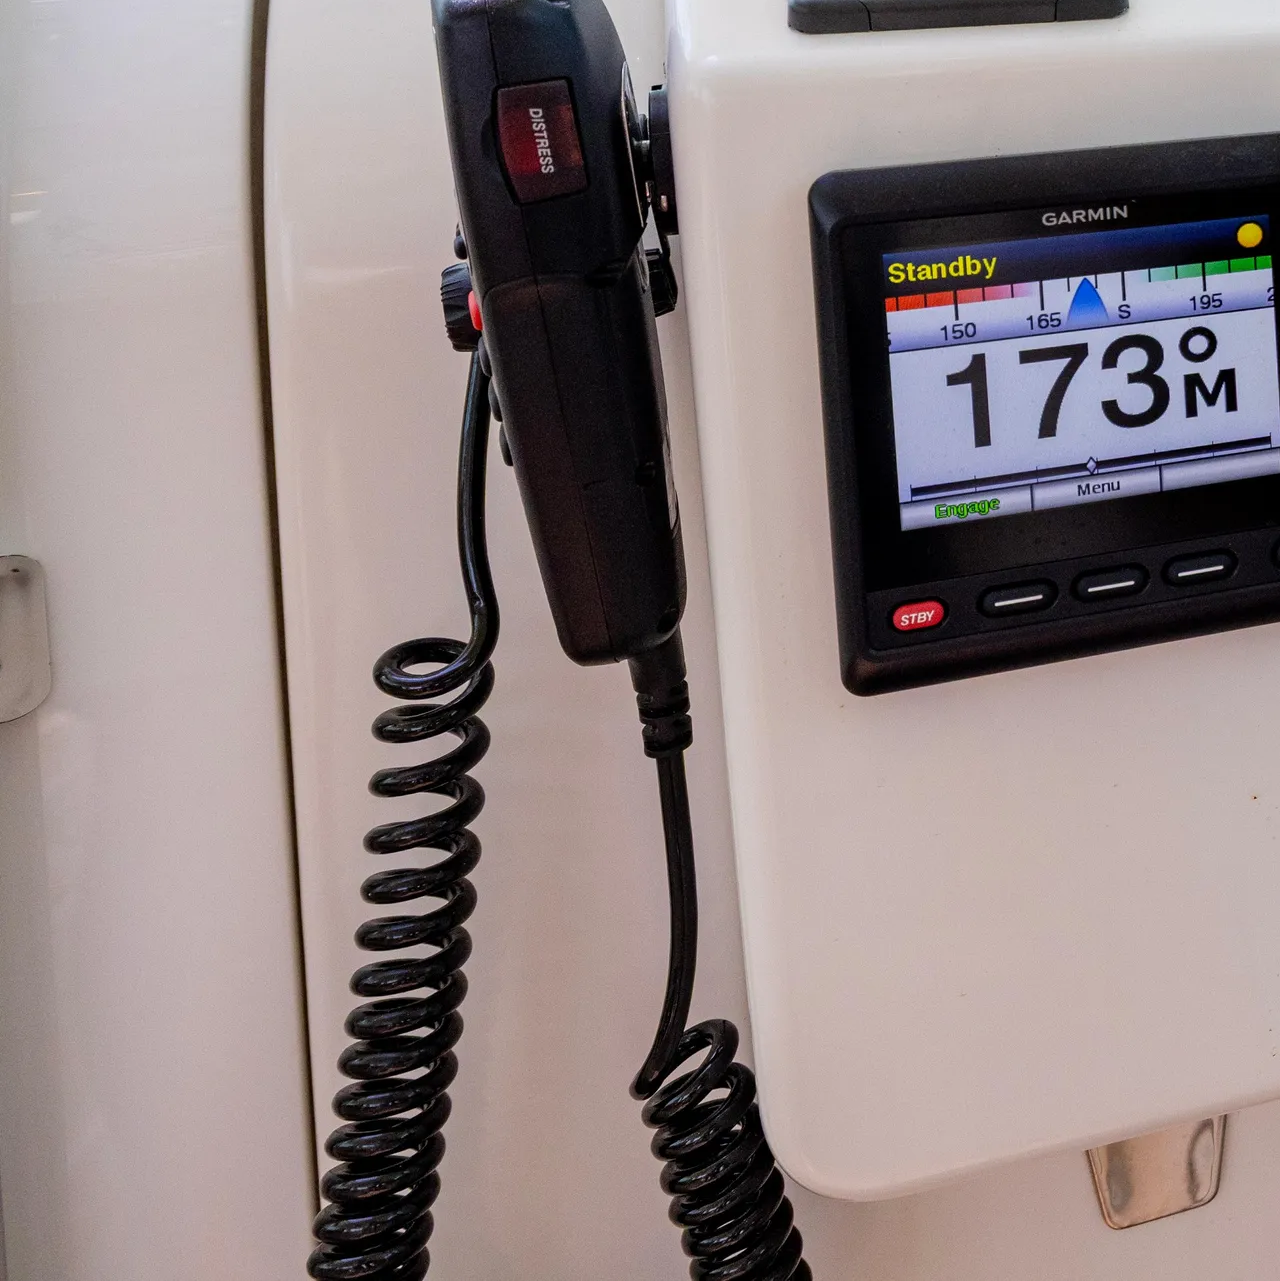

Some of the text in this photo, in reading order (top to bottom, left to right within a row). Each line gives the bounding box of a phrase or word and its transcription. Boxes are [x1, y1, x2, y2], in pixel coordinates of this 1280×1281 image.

[529, 108, 555, 174] DISTRESS
[1041, 205, 1129, 226] GARMIN
[887, 255, 997, 284] Standby
[940, 293, 1223, 341] 150 165 S 195
[1077, 480, 1121, 497] Menu
[934, 498, 1000, 519] Engage
[900, 610, 935, 627] STBY
